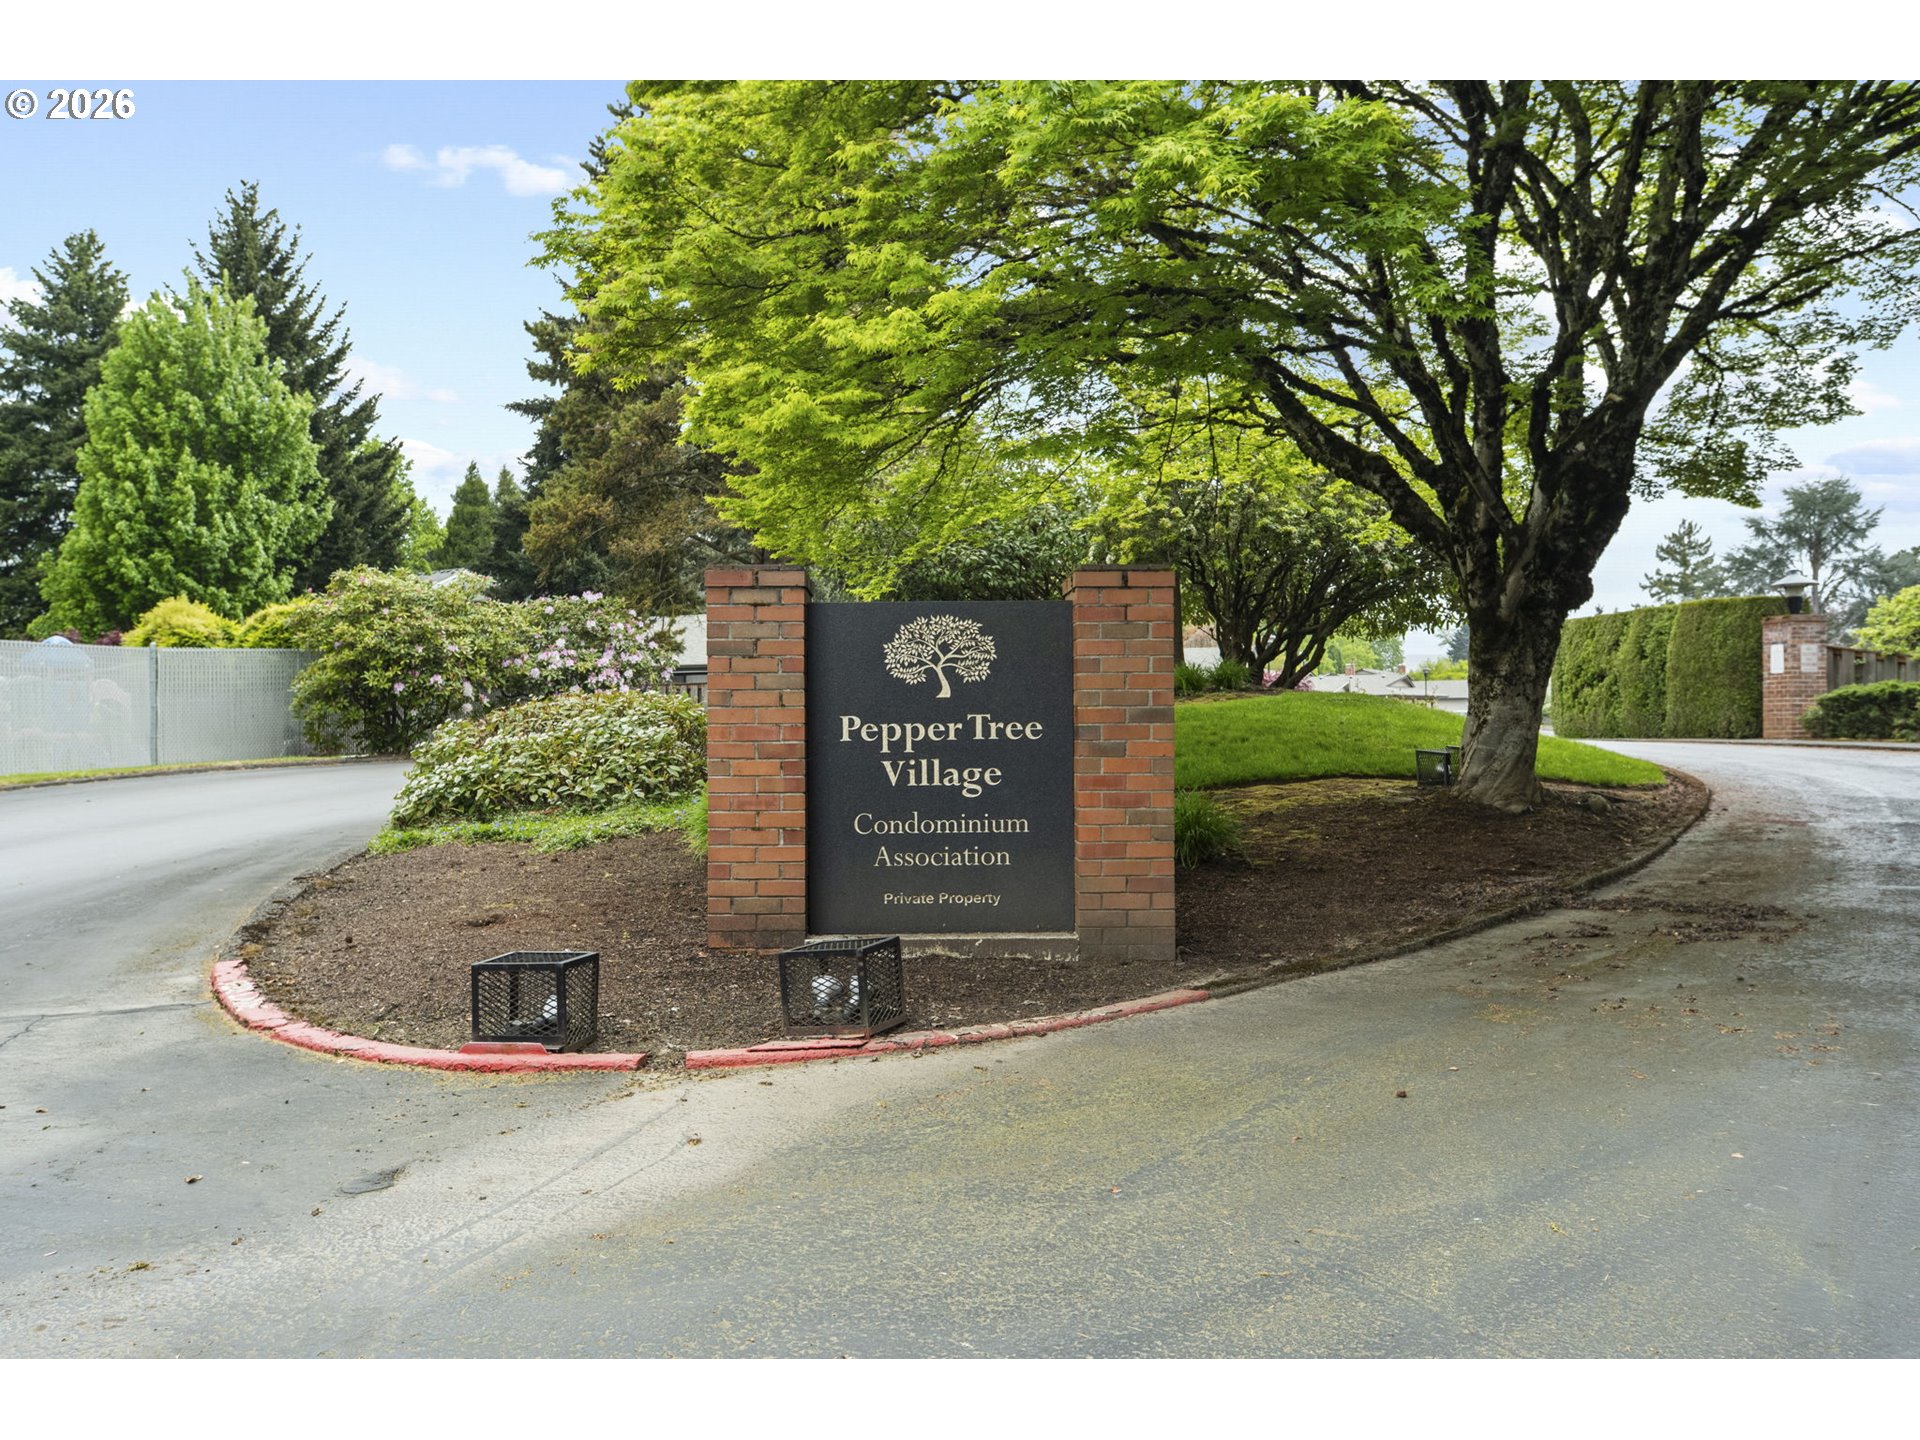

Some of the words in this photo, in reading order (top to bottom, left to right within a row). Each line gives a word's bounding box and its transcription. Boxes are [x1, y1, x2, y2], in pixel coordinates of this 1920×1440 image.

[839, 714, 962, 754] Pepper
[966, 713, 1043, 741] Tree
[881, 758, 1002, 798] Village
[853, 811, 1029, 835] Condominium
[873, 845, 1010, 867] Association
[883, 892, 935, 905] Private
[938, 893, 1001, 907] Property
